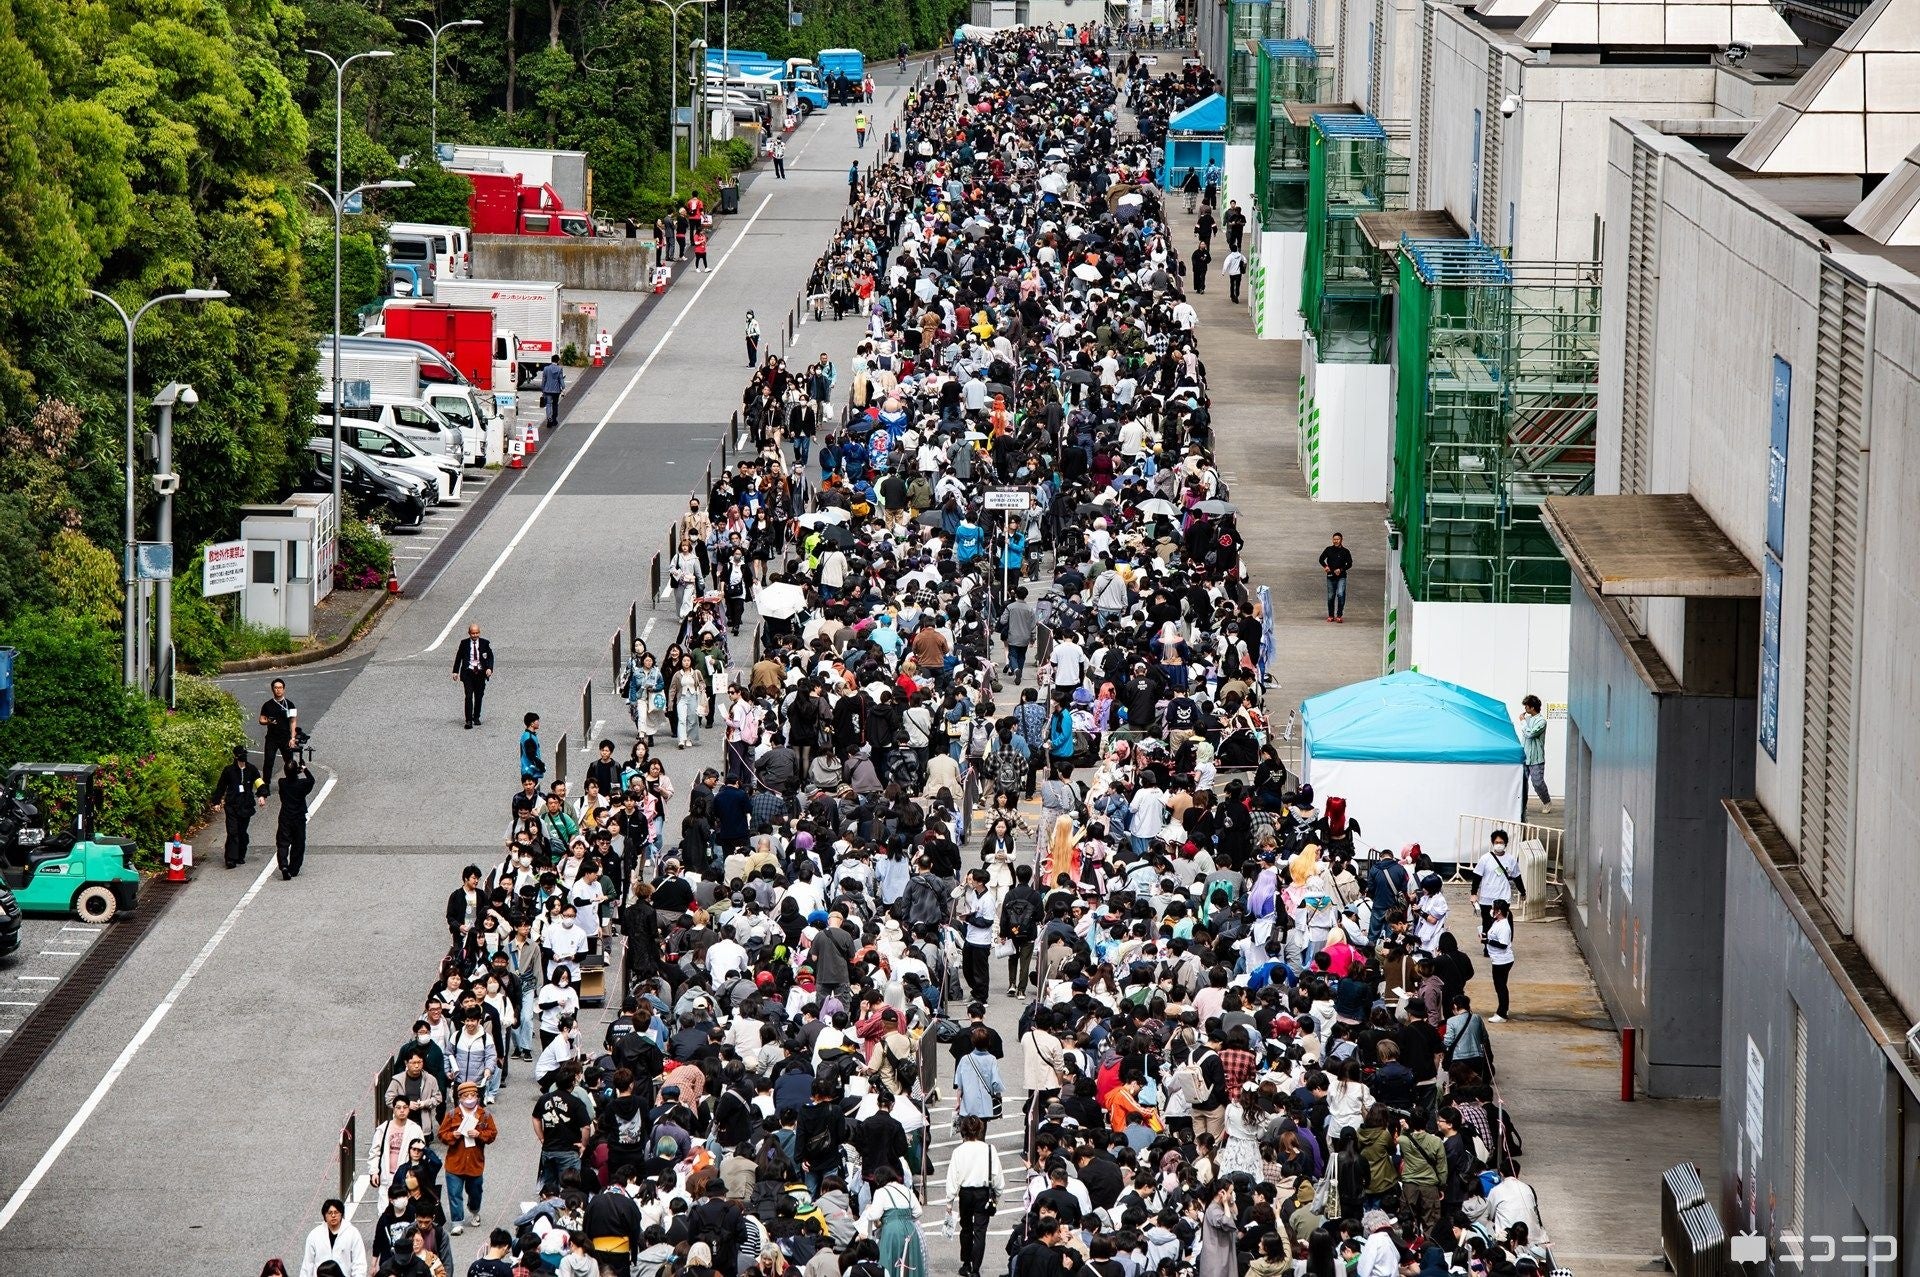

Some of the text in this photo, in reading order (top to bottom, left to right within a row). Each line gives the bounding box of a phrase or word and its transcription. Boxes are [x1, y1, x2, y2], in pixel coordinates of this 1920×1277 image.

[514, 443, 520, 452] E
[208, 546, 245, 562] 敷地外作業禁止
